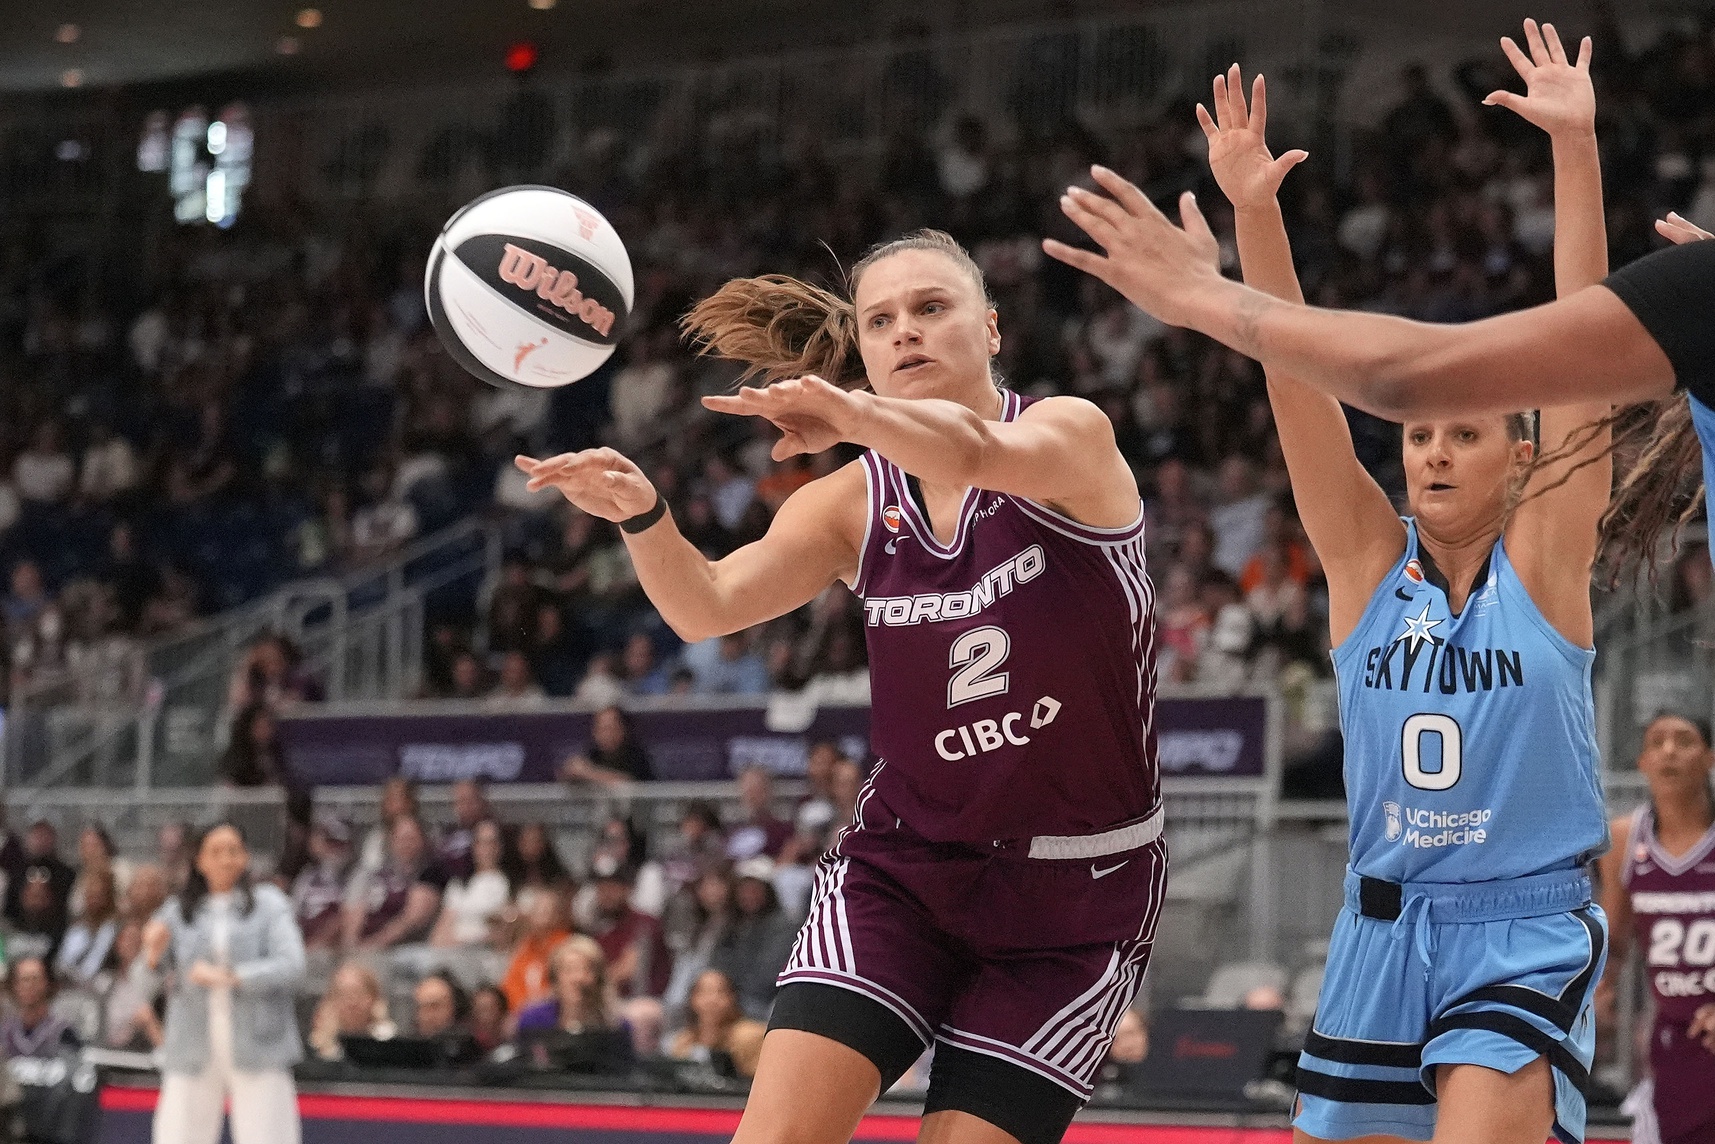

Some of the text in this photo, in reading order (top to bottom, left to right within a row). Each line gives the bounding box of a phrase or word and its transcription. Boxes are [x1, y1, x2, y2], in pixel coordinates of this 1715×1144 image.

[498, 243, 616, 337] Wilson
[973, 496, 1005, 527] PHORA
[864, 543, 1046, 627] TORONTO
[947, 625, 1011, 709] 2
[1365, 634, 1524, 695] SKYTOWN
[934, 712, 1031, 762] CIBC
[1401, 712, 1463, 791] 0
[1406, 808, 1492, 828] UChicago
[1648, 918, 1715, 967] 20
